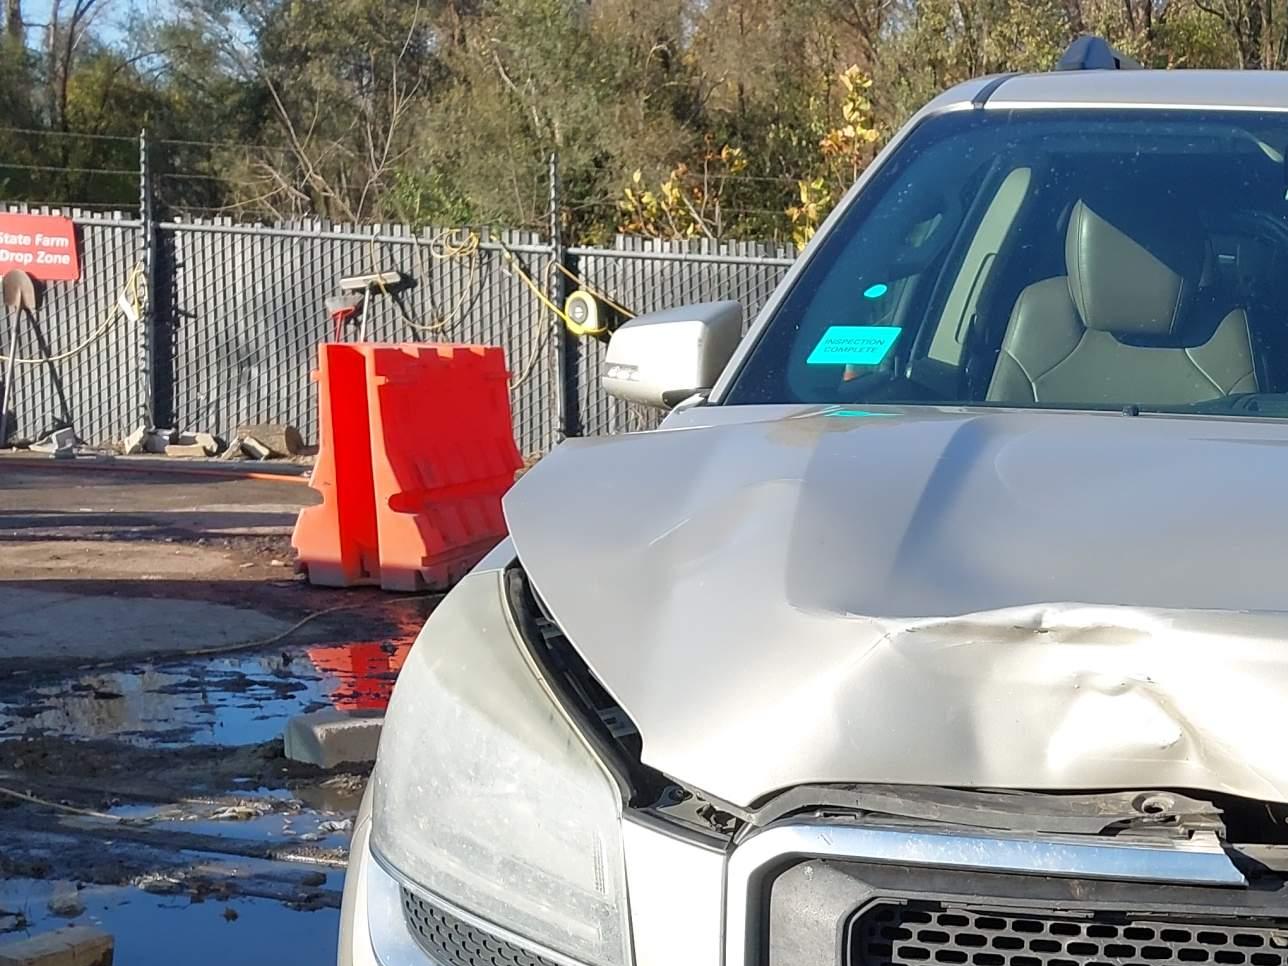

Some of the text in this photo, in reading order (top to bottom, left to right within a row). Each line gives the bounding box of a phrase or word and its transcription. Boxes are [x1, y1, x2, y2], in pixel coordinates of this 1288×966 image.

[35, 233, 69, 248] Farm
[0, 249, 71, 266] Drop Zone
[824, 337, 885, 345] INSPECTION
